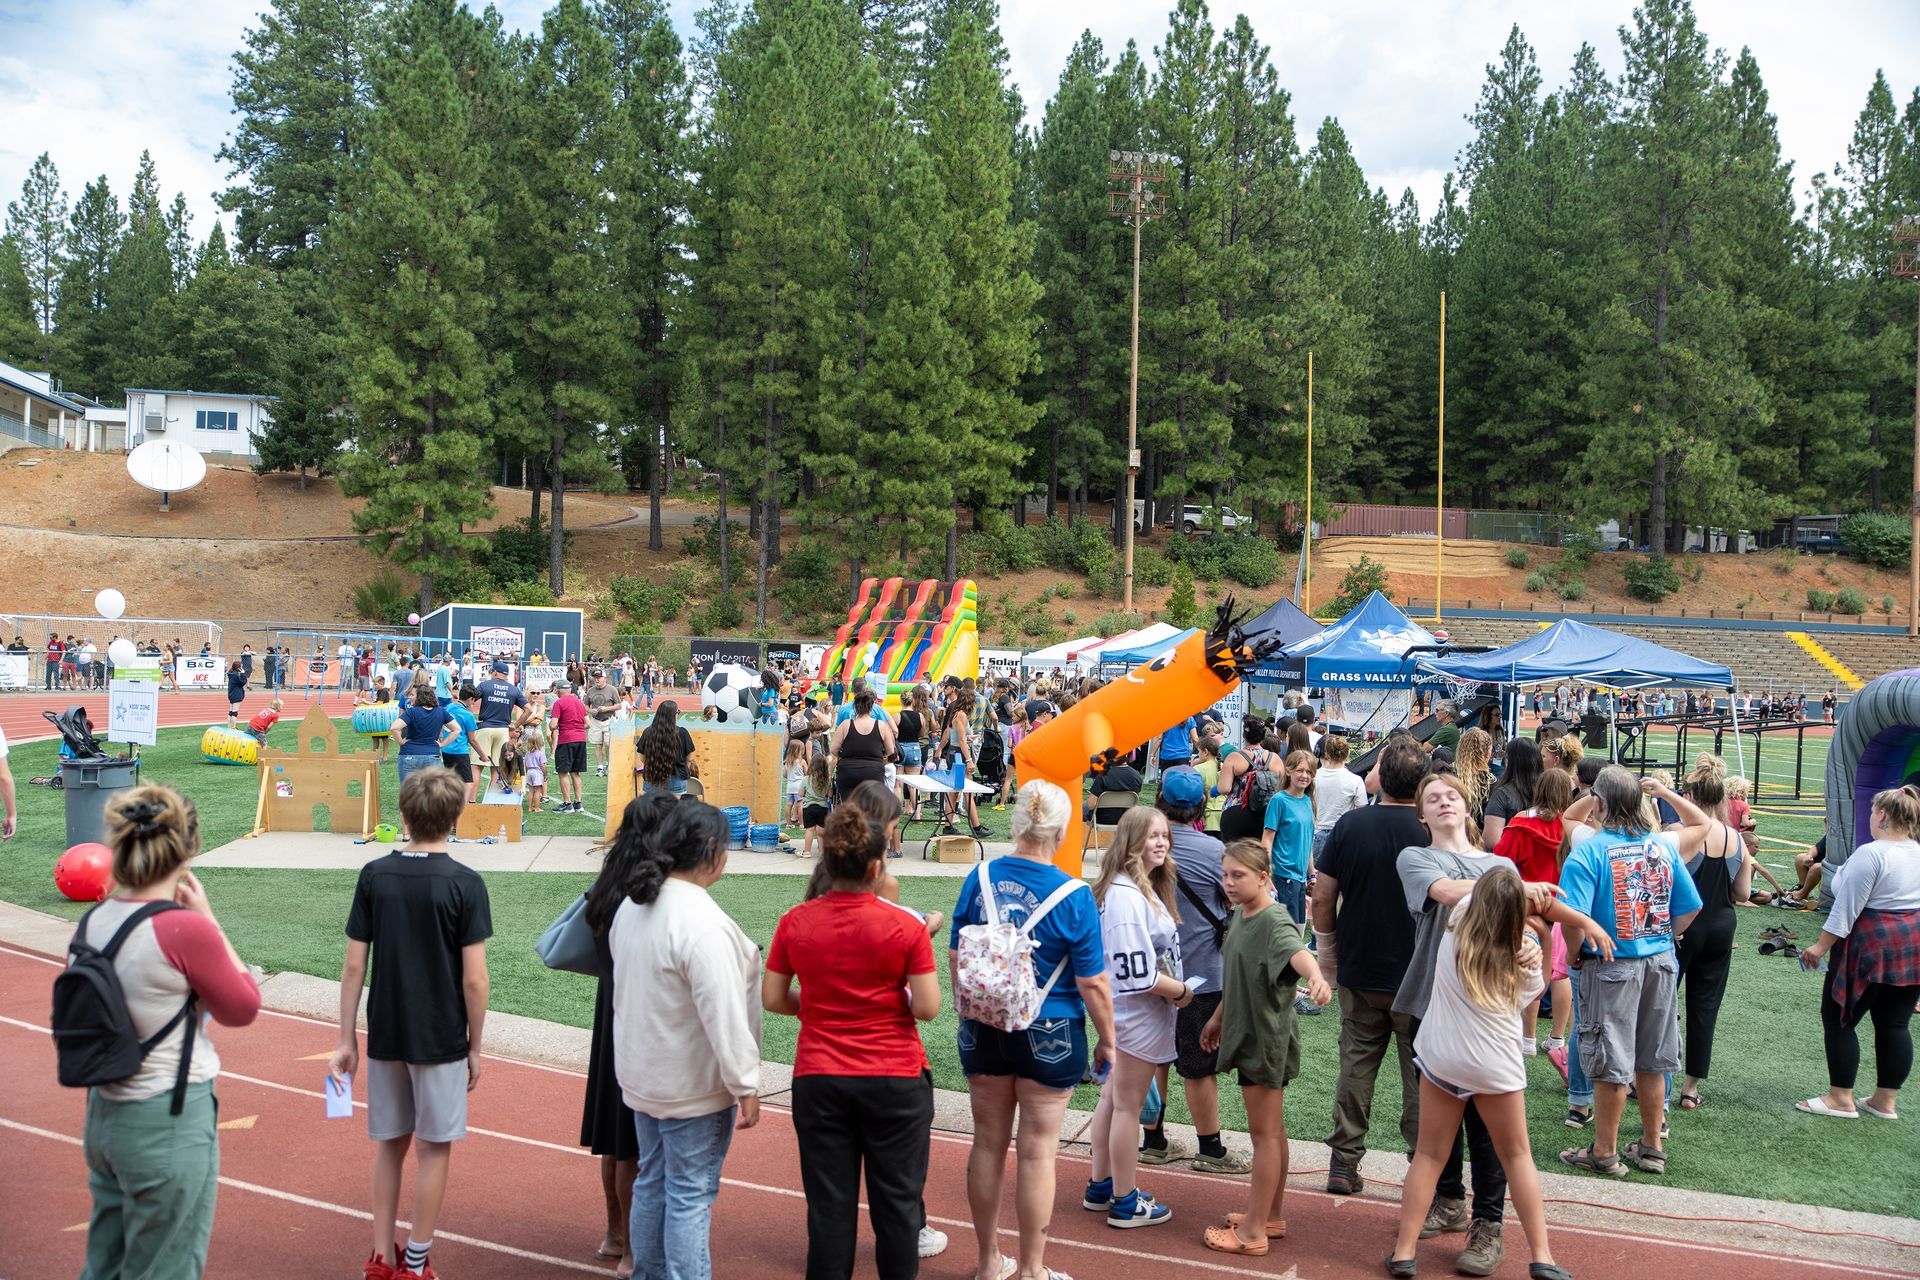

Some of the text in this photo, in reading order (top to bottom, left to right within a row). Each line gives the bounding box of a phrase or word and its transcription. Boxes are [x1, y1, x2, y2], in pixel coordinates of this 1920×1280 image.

[693, 653, 714, 661] ZION
[768, 651, 799, 659] Spotless
[989, 657, 1020, 667] Solar
[1322, 672, 1361, 682] GRASS
[1365, 673, 1407, 683] VALLEY
[487, 696, 510, 704] COMPETE
[1638, 891, 1652, 902] 18
[1113, 951, 1149, 980] 30
